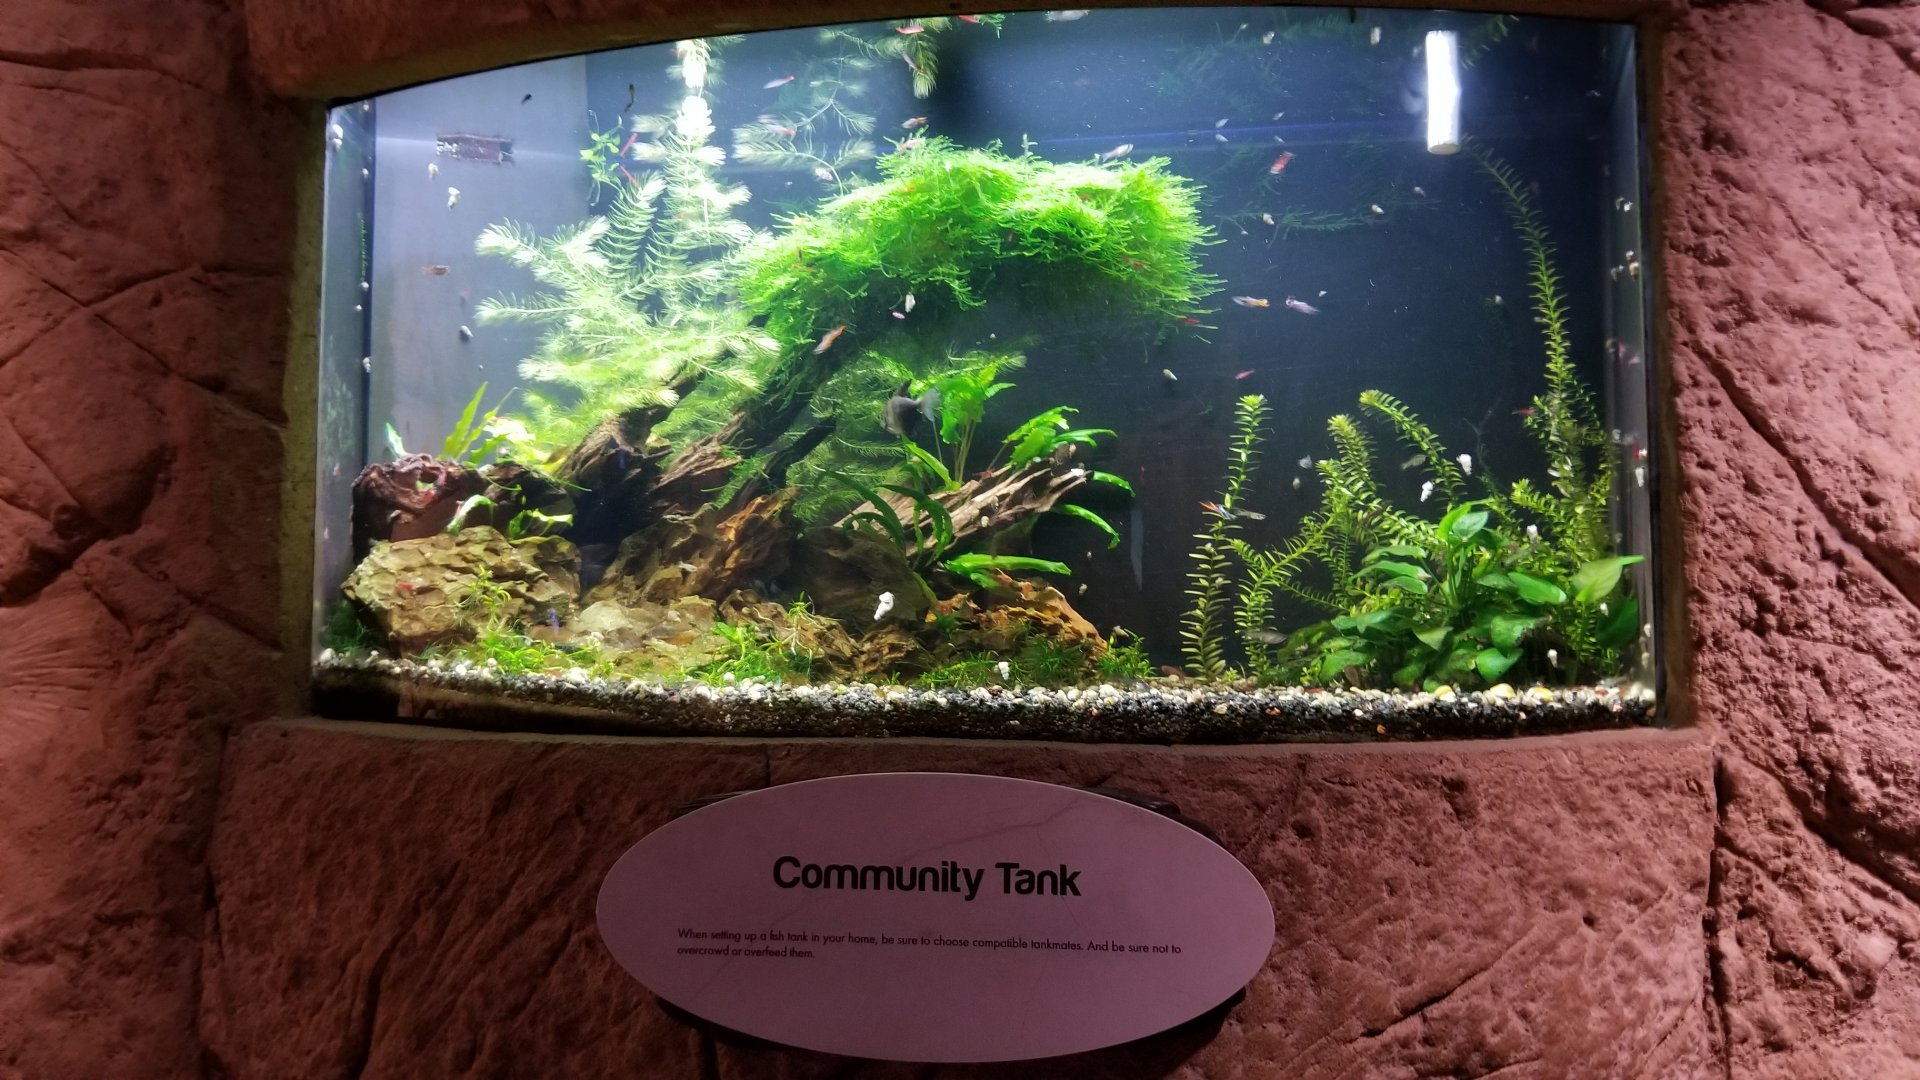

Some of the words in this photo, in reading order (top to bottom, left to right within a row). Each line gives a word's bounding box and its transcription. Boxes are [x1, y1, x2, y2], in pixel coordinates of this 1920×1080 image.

[774, 857, 984, 902] Community
[996, 863, 1082, 897] Tank
[677, 928, 708, 939] When
[711, 930, 741, 943] setting
[744, 933, 757, 944] up
[760, 934, 767, 942] a
[769, 931, 785, 943] fish
[787, 932, 807, 943] tank
[812, 932, 820, 943] in
[823, 935, 845, 945] your
[848, 932, 878, 946] home,
[882, 933, 894, 945] be
[897, 936, 918, 945] sure
[921, 936, 930, 946] to
[934, 935, 970, 947] choose
[973, 937, 1027, 950] compatible
[1030, 938, 1084, 951] tankmates.
[1087, 940, 1109, 952] And
[1112, 941, 1125, 953] be
[1128, 944, 1149, 953] sure
[1153, 943, 1169, 953] not
[1172, 945, 1182, 954] to
[677, 945, 729, 956] overcrowd
[732, 948, 741, 956] or
[744, 946, 788, 958] overfeed
[790, 946, 816, 959] them.
